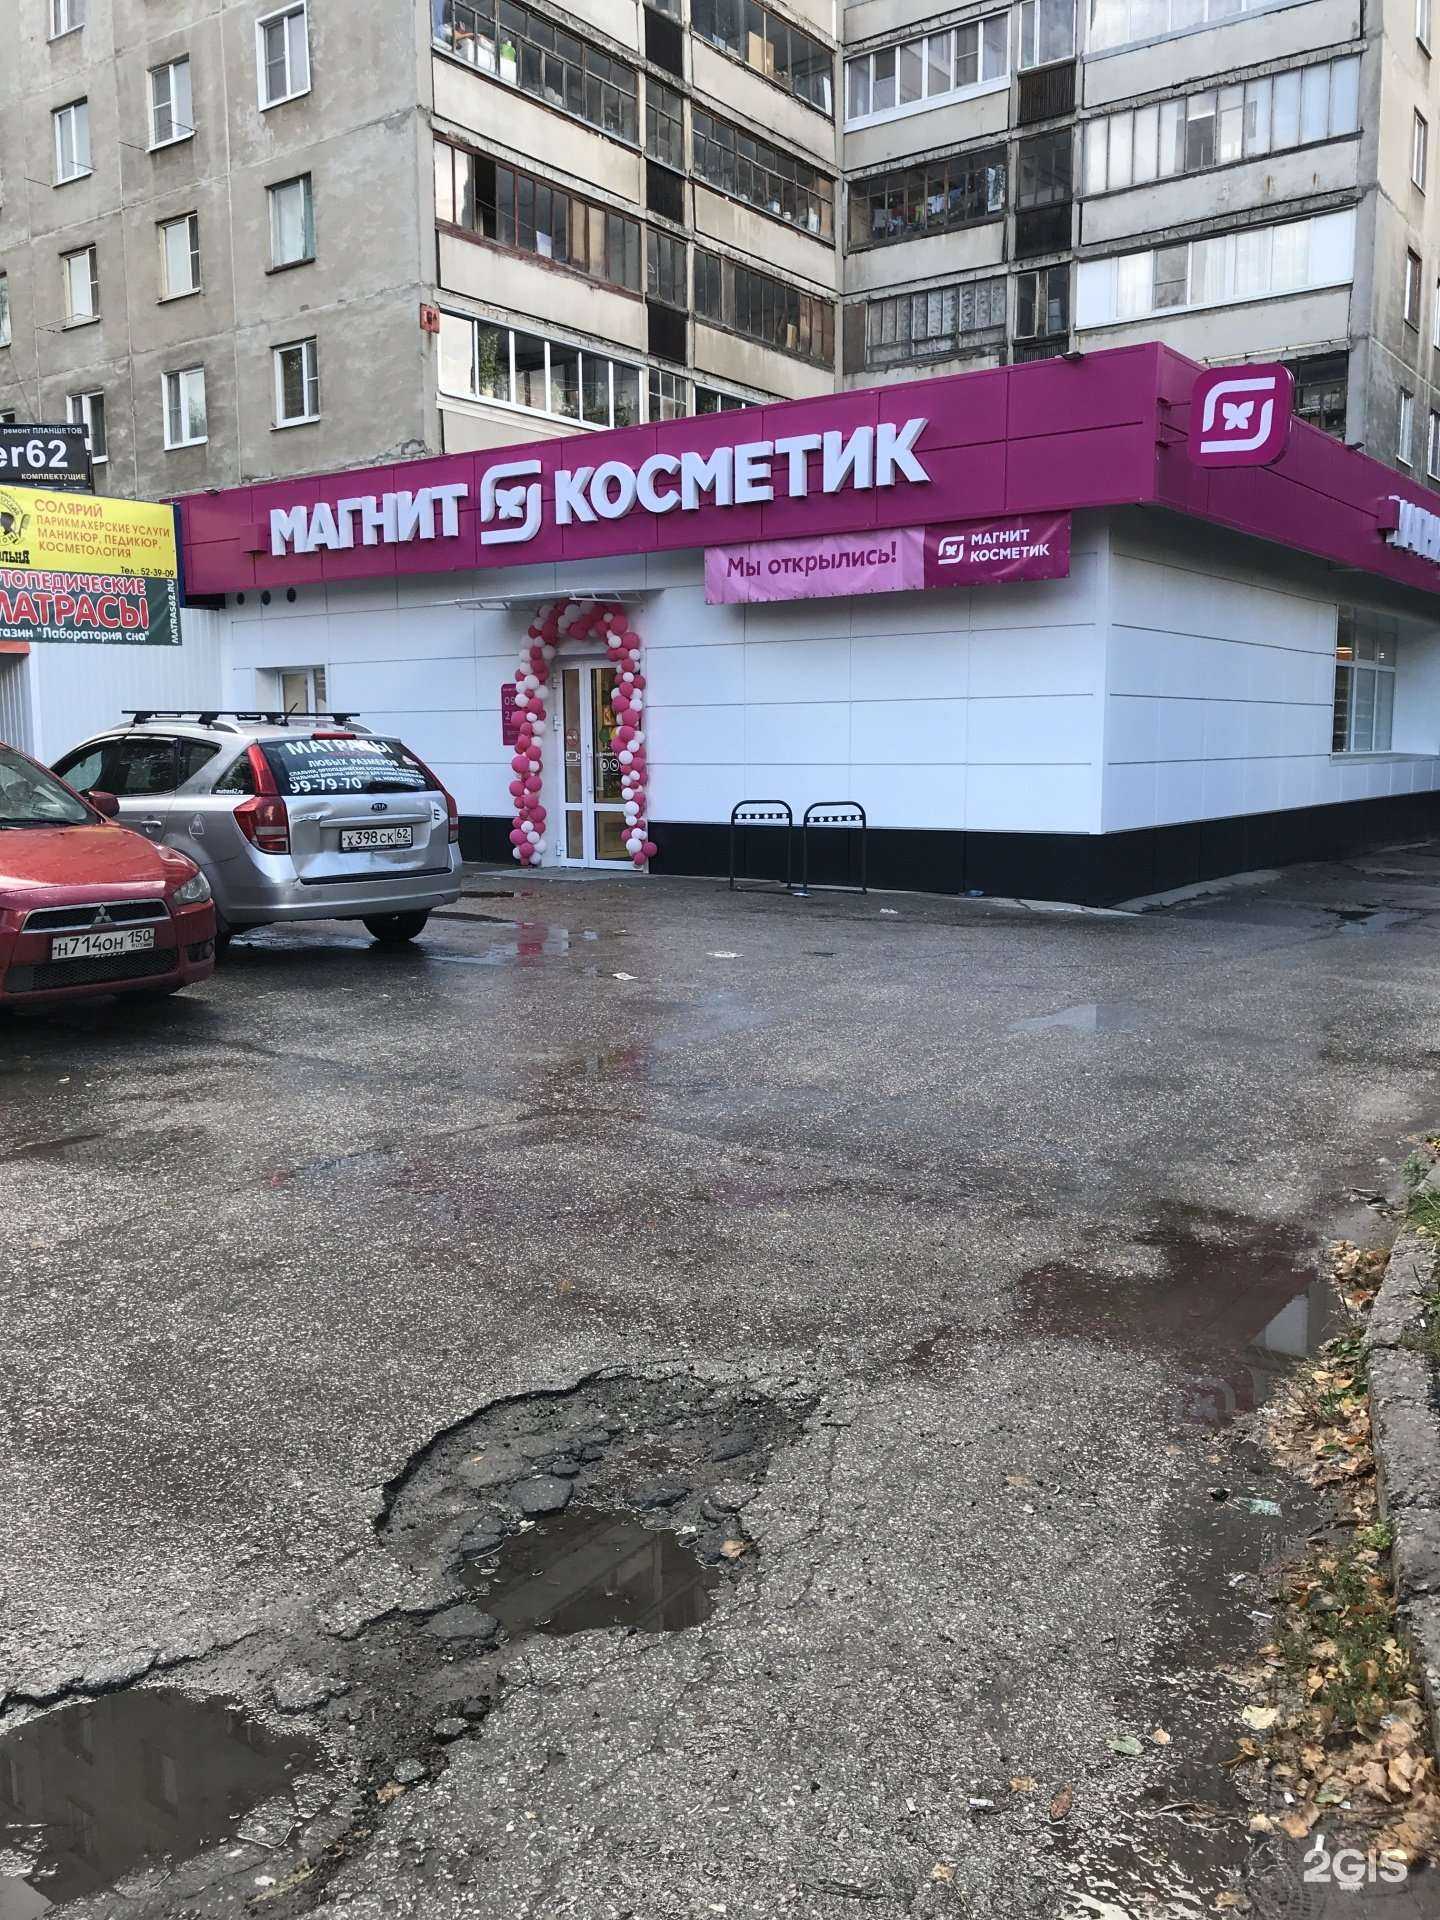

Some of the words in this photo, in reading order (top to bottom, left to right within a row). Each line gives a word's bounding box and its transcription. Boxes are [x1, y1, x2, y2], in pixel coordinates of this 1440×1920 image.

[270, 483, 468, 556] МАГНИТ
[555, 418, 931, 525] КОСМЕТИК
[34, 499, 103, 518] СОЛЯРИЙ
[37, 515, 130, 534] ПАРИКМАХЕРСКИЕ
[131, 525, 170, 537] УСЛУГИ
[104, 534, 161, 549] ПЕДИКЮР,
[971, 528, 1031, 546] МАГНИТ
[0, 550, 30, 564] ЛЬНЯ
[39, 541, 132, 558] КОСМЕТОЛОГИЯ
[970, 543, 1049, 563] КОСМЕТИК
[727, 557, 761, 577] Мы
[768, 541, 897, 577] открылись!
[141, 568, 174, 577] 52-39-09
[0, 569, 146, 596] ТОПЕДИЧЕСКИЕ
[167, 580, 179, 644] MATRAS62.RU
[37, 627, 122, 642] "Лаборатория
[126, 632, 149, 642] сна"
[308, 759, 348, 768] ЛЮБЫХ
[350, 758, 399, 767] РАЗМЕРОВ
[290, 777, 362, 793] 99-79-70
[396, 828, 408, 838] 62
[128, 930, 151, 943] 150
